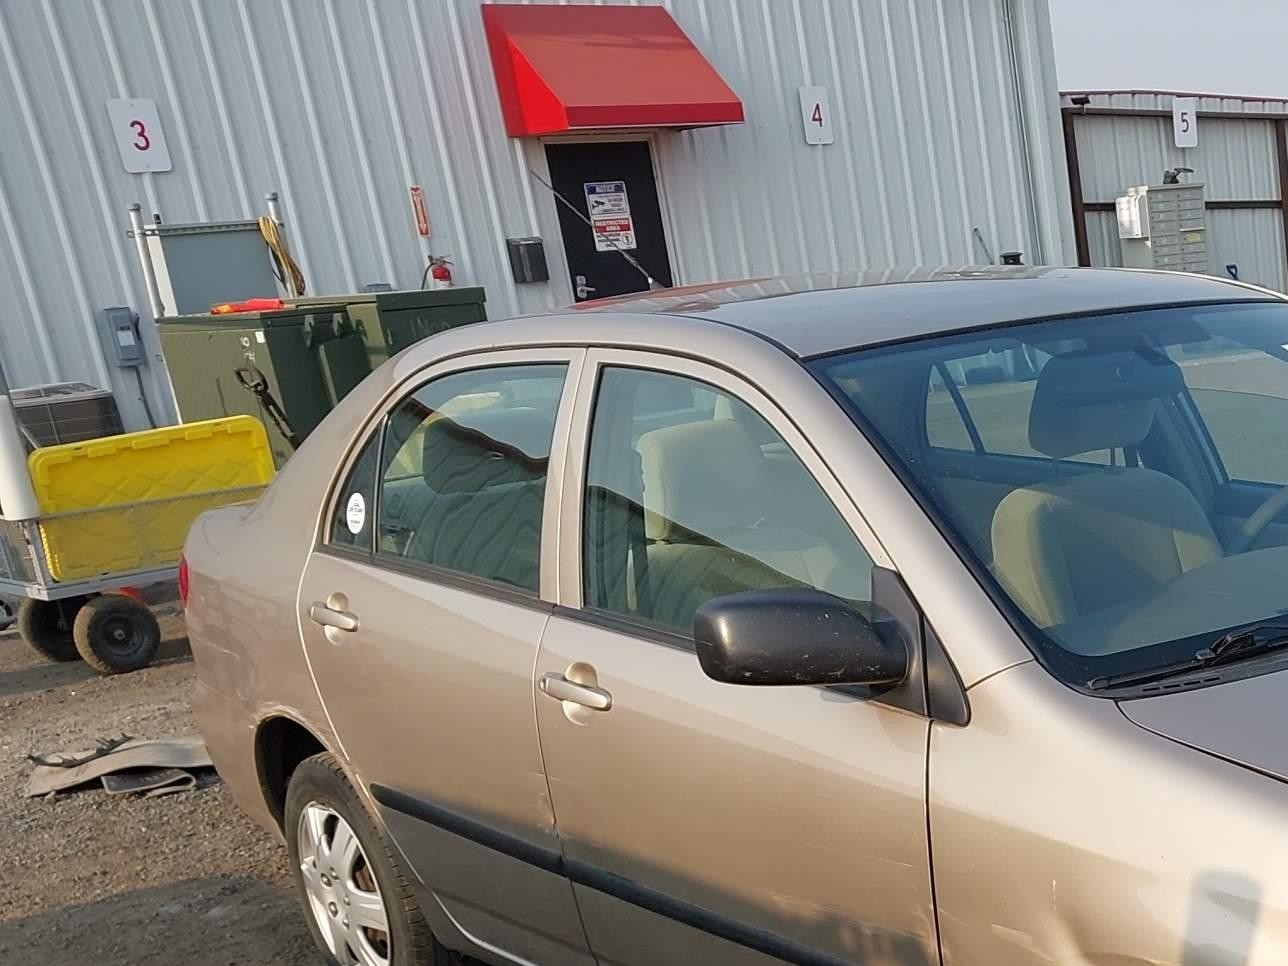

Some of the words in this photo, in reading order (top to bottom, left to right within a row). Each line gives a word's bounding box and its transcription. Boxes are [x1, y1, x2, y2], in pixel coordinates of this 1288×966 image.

[812, 103, 823, 127] 4
[1181, 112, 1190, 133] 5
[130, 120, 150, 151] 3
